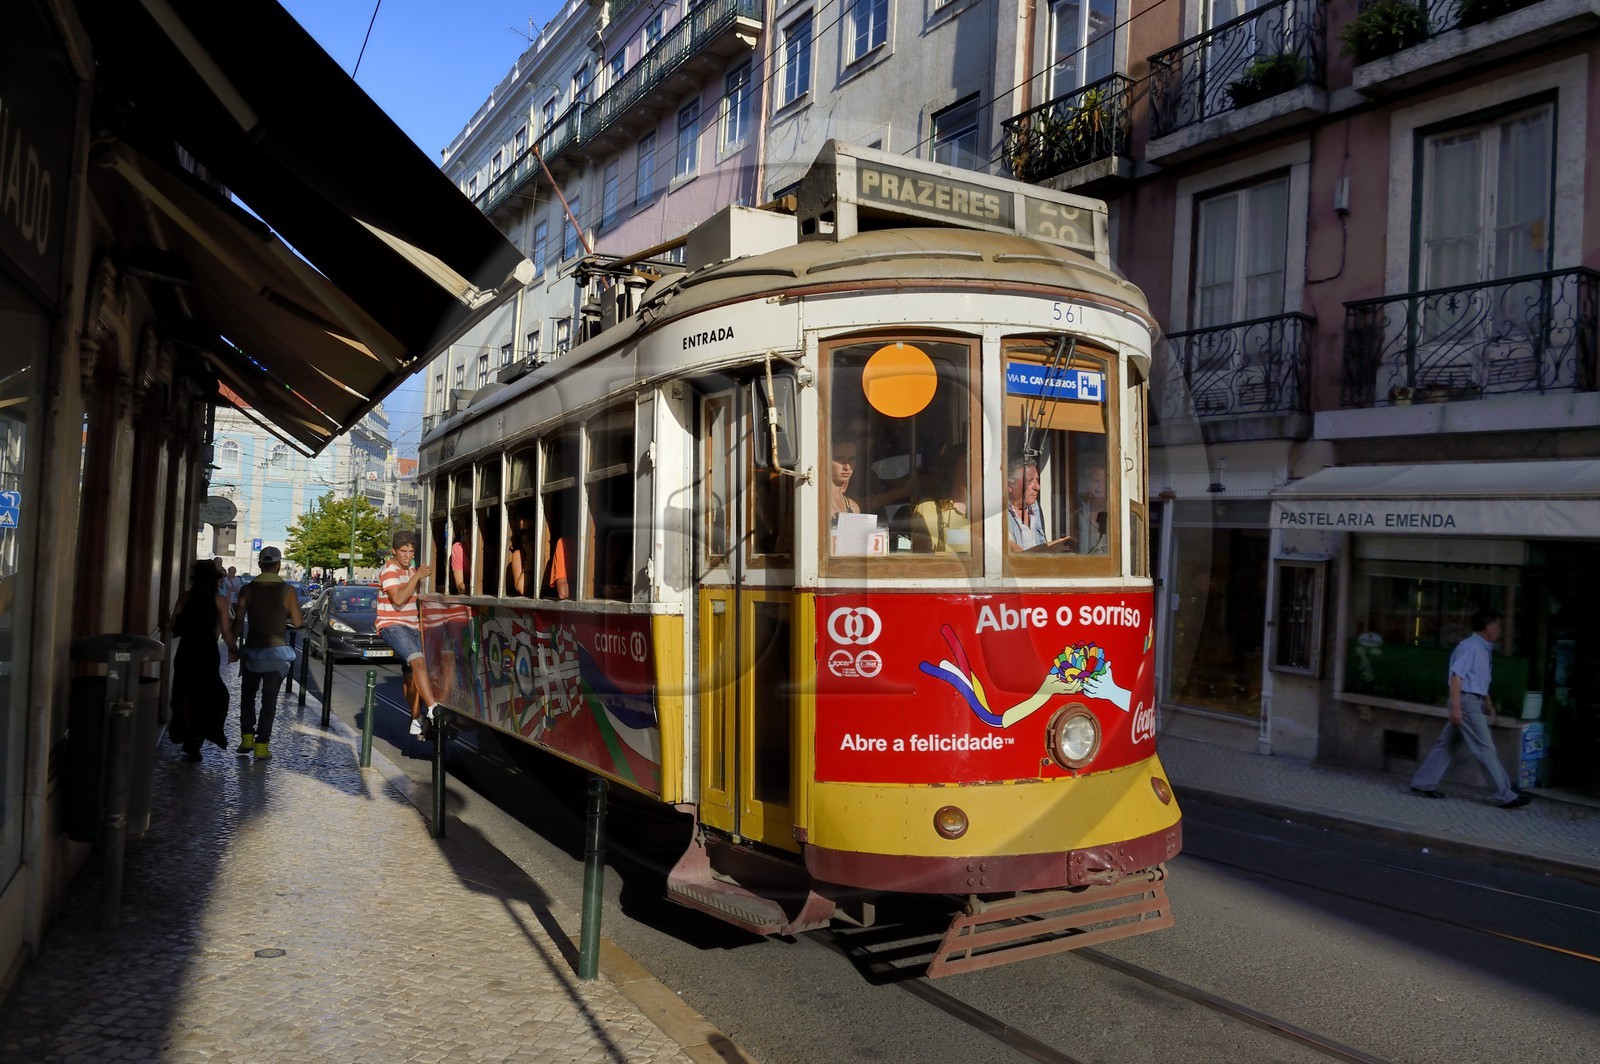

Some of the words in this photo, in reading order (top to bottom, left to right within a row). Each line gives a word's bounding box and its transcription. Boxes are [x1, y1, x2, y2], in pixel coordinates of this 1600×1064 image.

[862, 168, 1000, 220] PRAZERES
[1053, 302, 1083, 325] 561
[682, 326, 735, 350] ENTRADA
[1007, 373, 1020, 384] VIA
[1020, 374, 1029, 385] R.
[1279, 511, 1375, 527] PASTELARIA
[1385, 513, 1457, 528] EMENDA
[975, 603, 1048, 634] Abre
[1055, 605, 1073, 627] o
[1079, 600, 1141, 629] sorriso
[594, 627, 627, 656] carris
[840, 733, 888, 751] Abre
[893, 738, 905, 751] a
